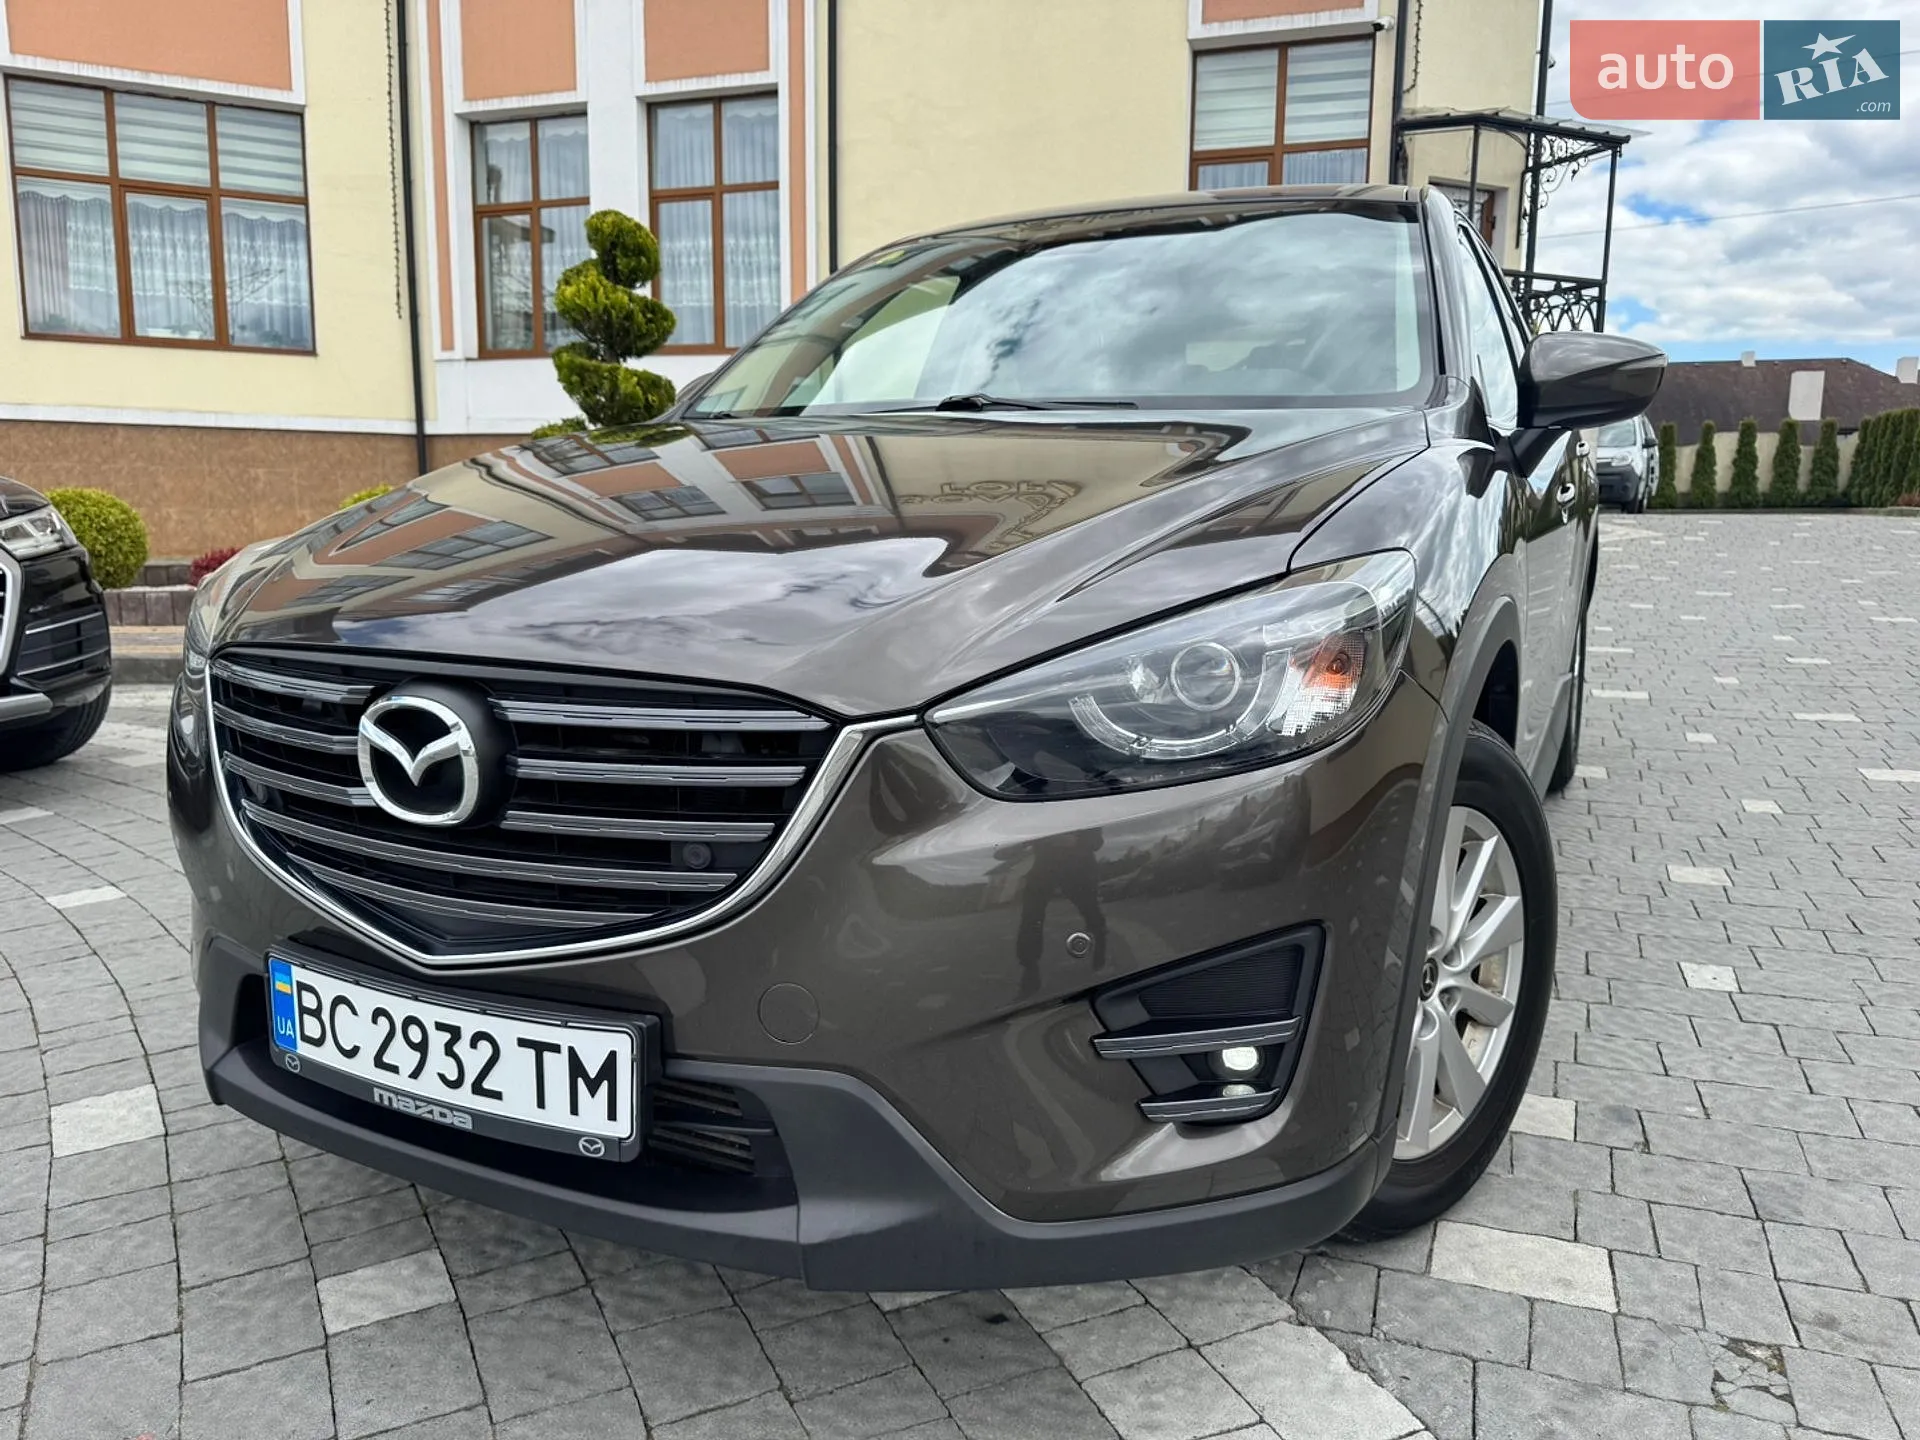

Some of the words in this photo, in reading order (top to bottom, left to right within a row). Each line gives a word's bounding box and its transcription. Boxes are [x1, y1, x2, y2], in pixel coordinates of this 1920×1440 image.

[277, 1017, 295, 1039] UA
[296, 980, 361, 1059] BC
[371, 1006, 503, 1101] 2932
[517, 1037, 617, 1122] TM
